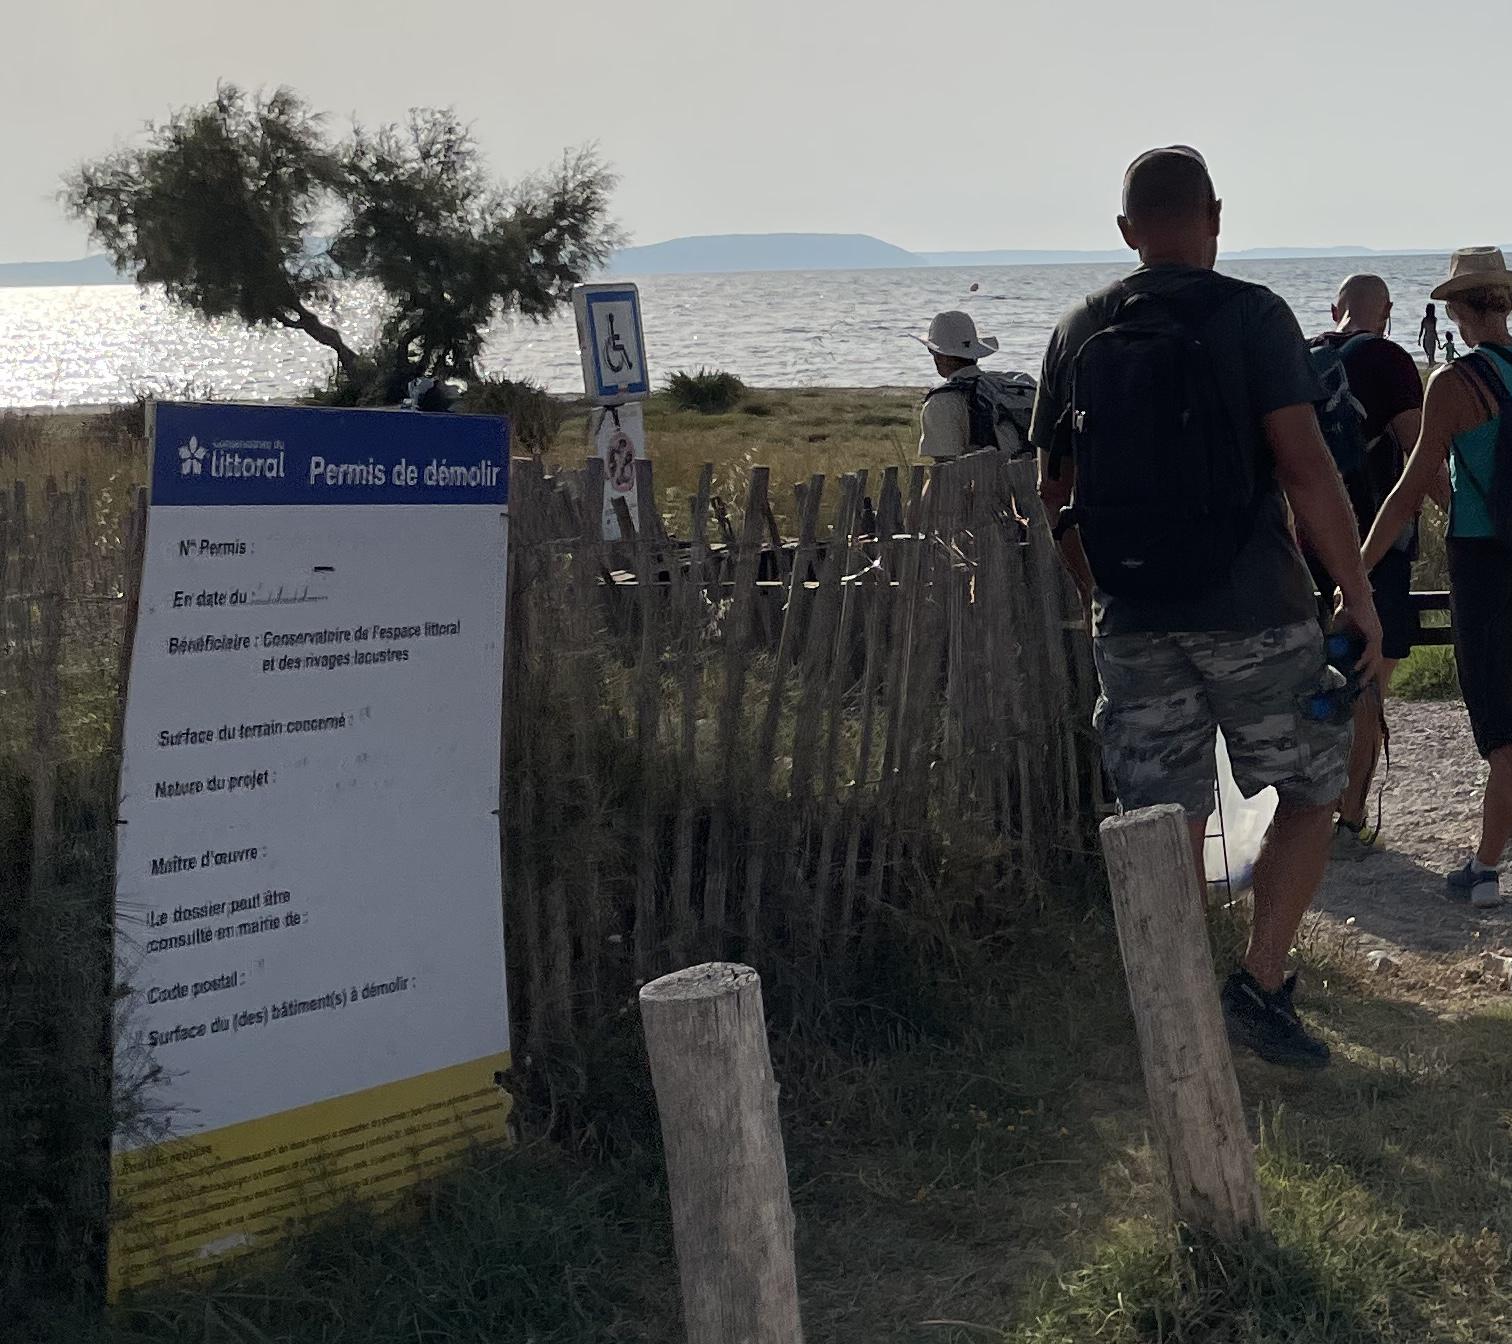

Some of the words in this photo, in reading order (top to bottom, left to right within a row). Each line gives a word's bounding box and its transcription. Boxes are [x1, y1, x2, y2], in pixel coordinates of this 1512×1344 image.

[311, 455, 386, 486] Permis
[392, 457, 418, 487] de
[424, 457, 501, 488] démolir
[199, 538, 246, 555] Permis
[173, 591, 192, 608] En
[196, 588, 226, 608] date
[229, 588, 248, 605] du
[169, 632, 251, 655] Bénéficiaire
[263, 626, 352, 648] Conservatoire
[354, 624, 369, 642] de
[371, 623, 421, 641] l'espace
[424, 619, 461, 637] littoral
[262, 656, 276, 673] et
[278, 653, 301, 670] des
[304, 651, 350, 671] rivages
[354, 647, 409, 665] lacustres
[159, 726, 214, 747] Surface
[218, 724, 236, 742] du
[239, 719, 282, 739] terrain
[286, 711, 346, 734] concerné
[154, 779, 203, 799] Nature
[206, 775, 225, 792] du
[227, 768, 270, 792] projet
[151, 855, 198, 876] Maître
[173, 901, 226, 924] dossier
[230, 894, 262, 916] peut
[216, 926, 235, 942] en
[238, 916, 281, 937] mairie
[285, 913, 302, 928] de
[146, 983, 189, 1005] Code
[191, 971, 239, 999] postal
[148, 1023, 207, 1047] Surface
[209, 1015, 231, 1034] du
[232, 1006, 269, 1033] (des)
[271, 989, 348, 1020] bâtiment(s)
[350, 988, 359, 1002] à
[361, 975, 409, 1000] démolir
